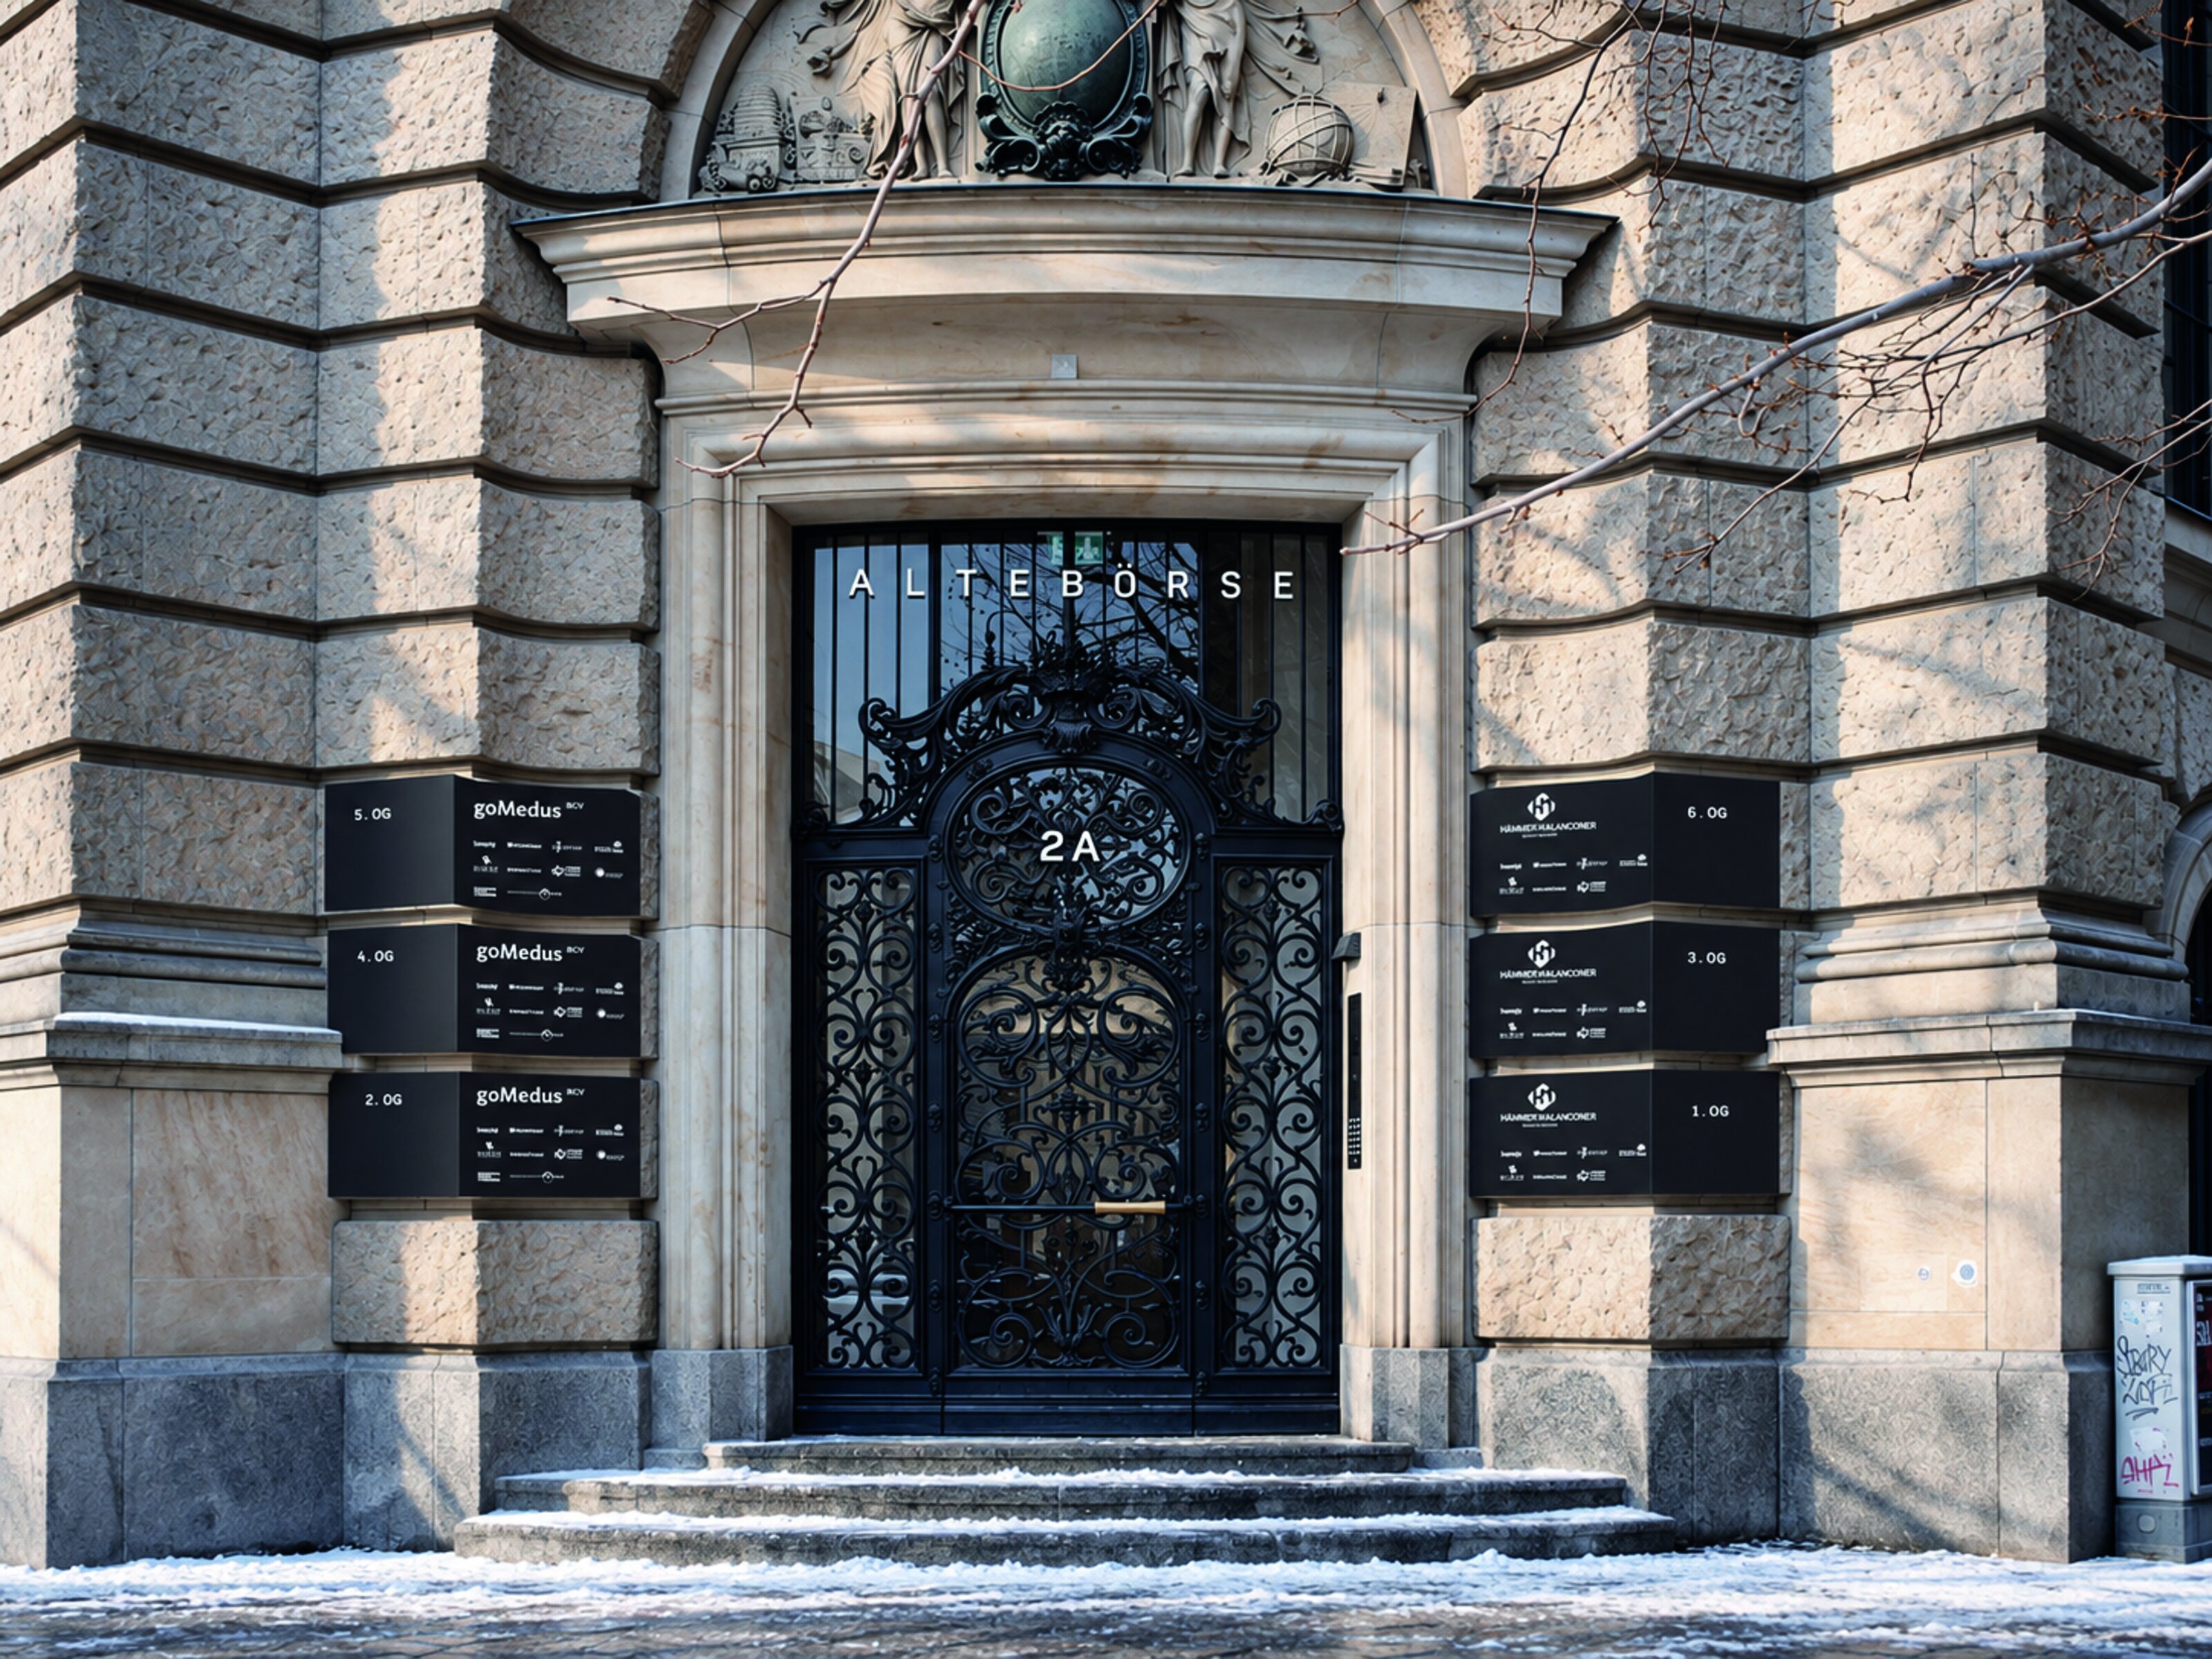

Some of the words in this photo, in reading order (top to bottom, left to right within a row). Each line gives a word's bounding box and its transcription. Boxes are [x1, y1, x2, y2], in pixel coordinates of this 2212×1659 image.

[474, 800, 561, 819] goMedus
[477, 944, 562, 962] goMedus
[477, 1087, 562, 1106] goMedus
